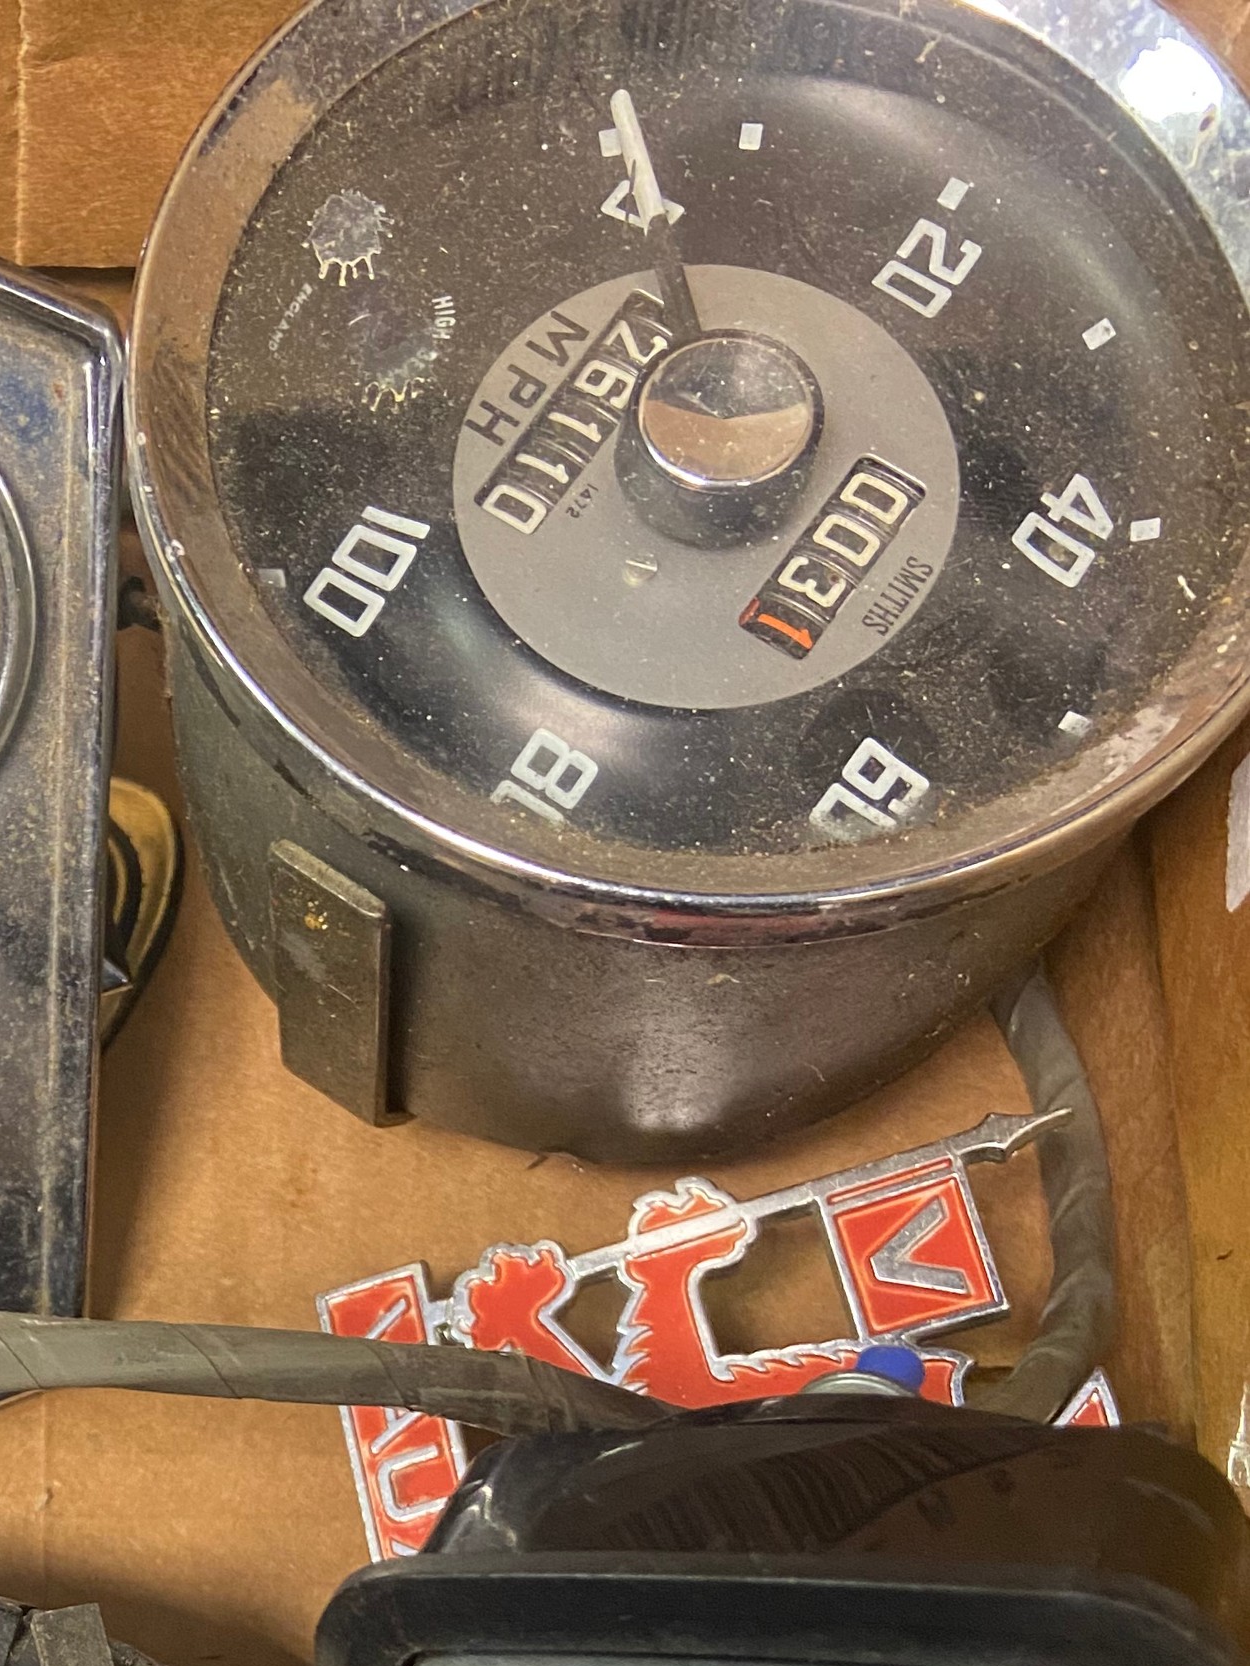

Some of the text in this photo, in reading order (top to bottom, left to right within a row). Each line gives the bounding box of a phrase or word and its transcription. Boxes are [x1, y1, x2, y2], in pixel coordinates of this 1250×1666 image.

[431, 294, 457, 341] HIGH
[872, 216, 982, 318] 20
[465, 310, 588, 445] MPH
[303, 505, 431, 638] 100
[1011, 472, 1114, 588] 40
[862, 556, 931, 635] SMITHS
[870, 1195, 969, 1296] V
